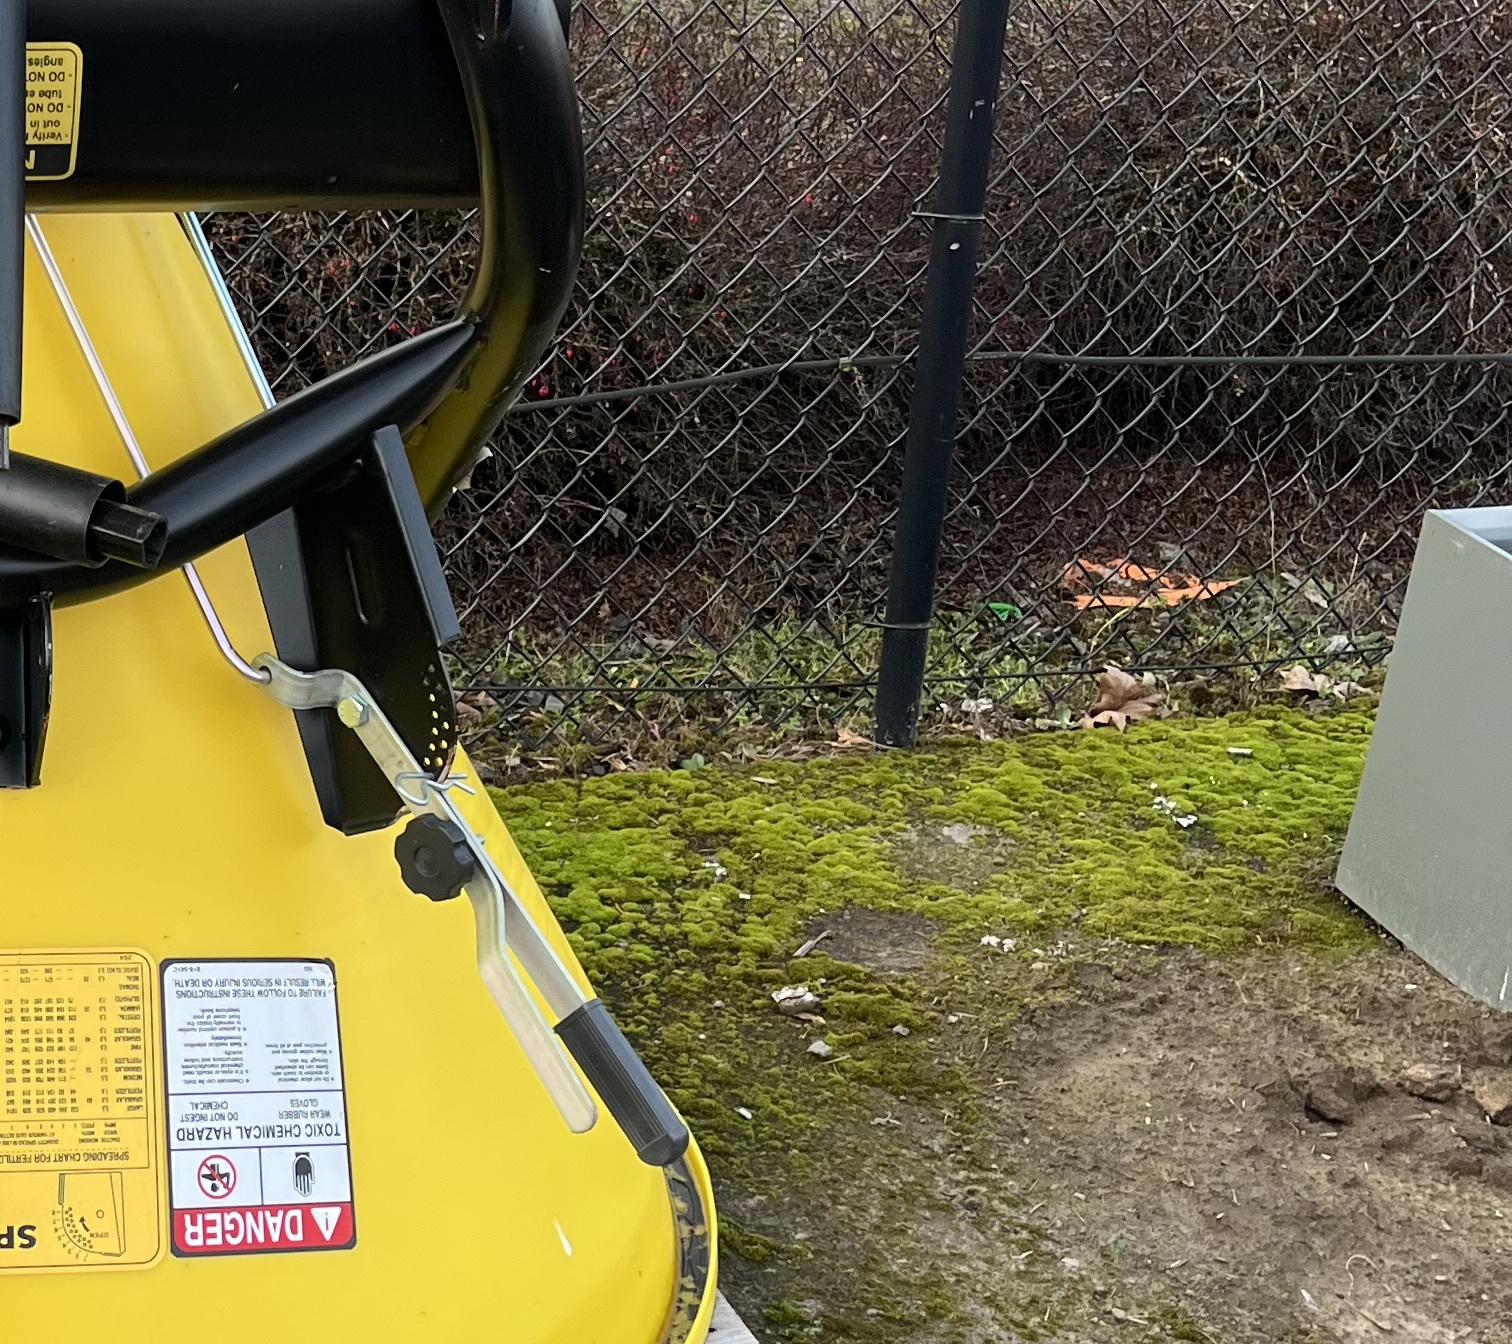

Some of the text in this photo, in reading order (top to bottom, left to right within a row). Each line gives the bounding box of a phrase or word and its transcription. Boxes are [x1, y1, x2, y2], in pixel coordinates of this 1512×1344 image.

[28, 56, 63, 67] angles
[49, 72, 65, 82] DO
[39, 90, 61, 100] tube
[46, 103, 63, 113] DO
[30, 120, 39, 129] in
[42, 120, 60, 128] out
[32, 131, 62, 141] Verify
[172, 978, 326, 988] WILL RESULT IN SERIOUS INJURY OR DEATH.
[176, 989, 326, 999] FAILURE TO FOLLOW THESE INSTRUCTIONS
[189, 1101, 228, 1110] CHEMICAL
[290, 1099, 318, 1108] GLOVES
[180, 1112, 238, 1122] DO NOT INGEST
[279, 1110, 331, 1119] WEAR RUBBER
[176, 1123, 340, 1141] TOXIC CHEMICAL HAZARD
[34, 1154, 51, 1163] FOR
[53, 1153, 81, 1162] CHART
[83, 1151, 129, 1162] SPREADING
[184, 1209, 303, 1246] DANGER
